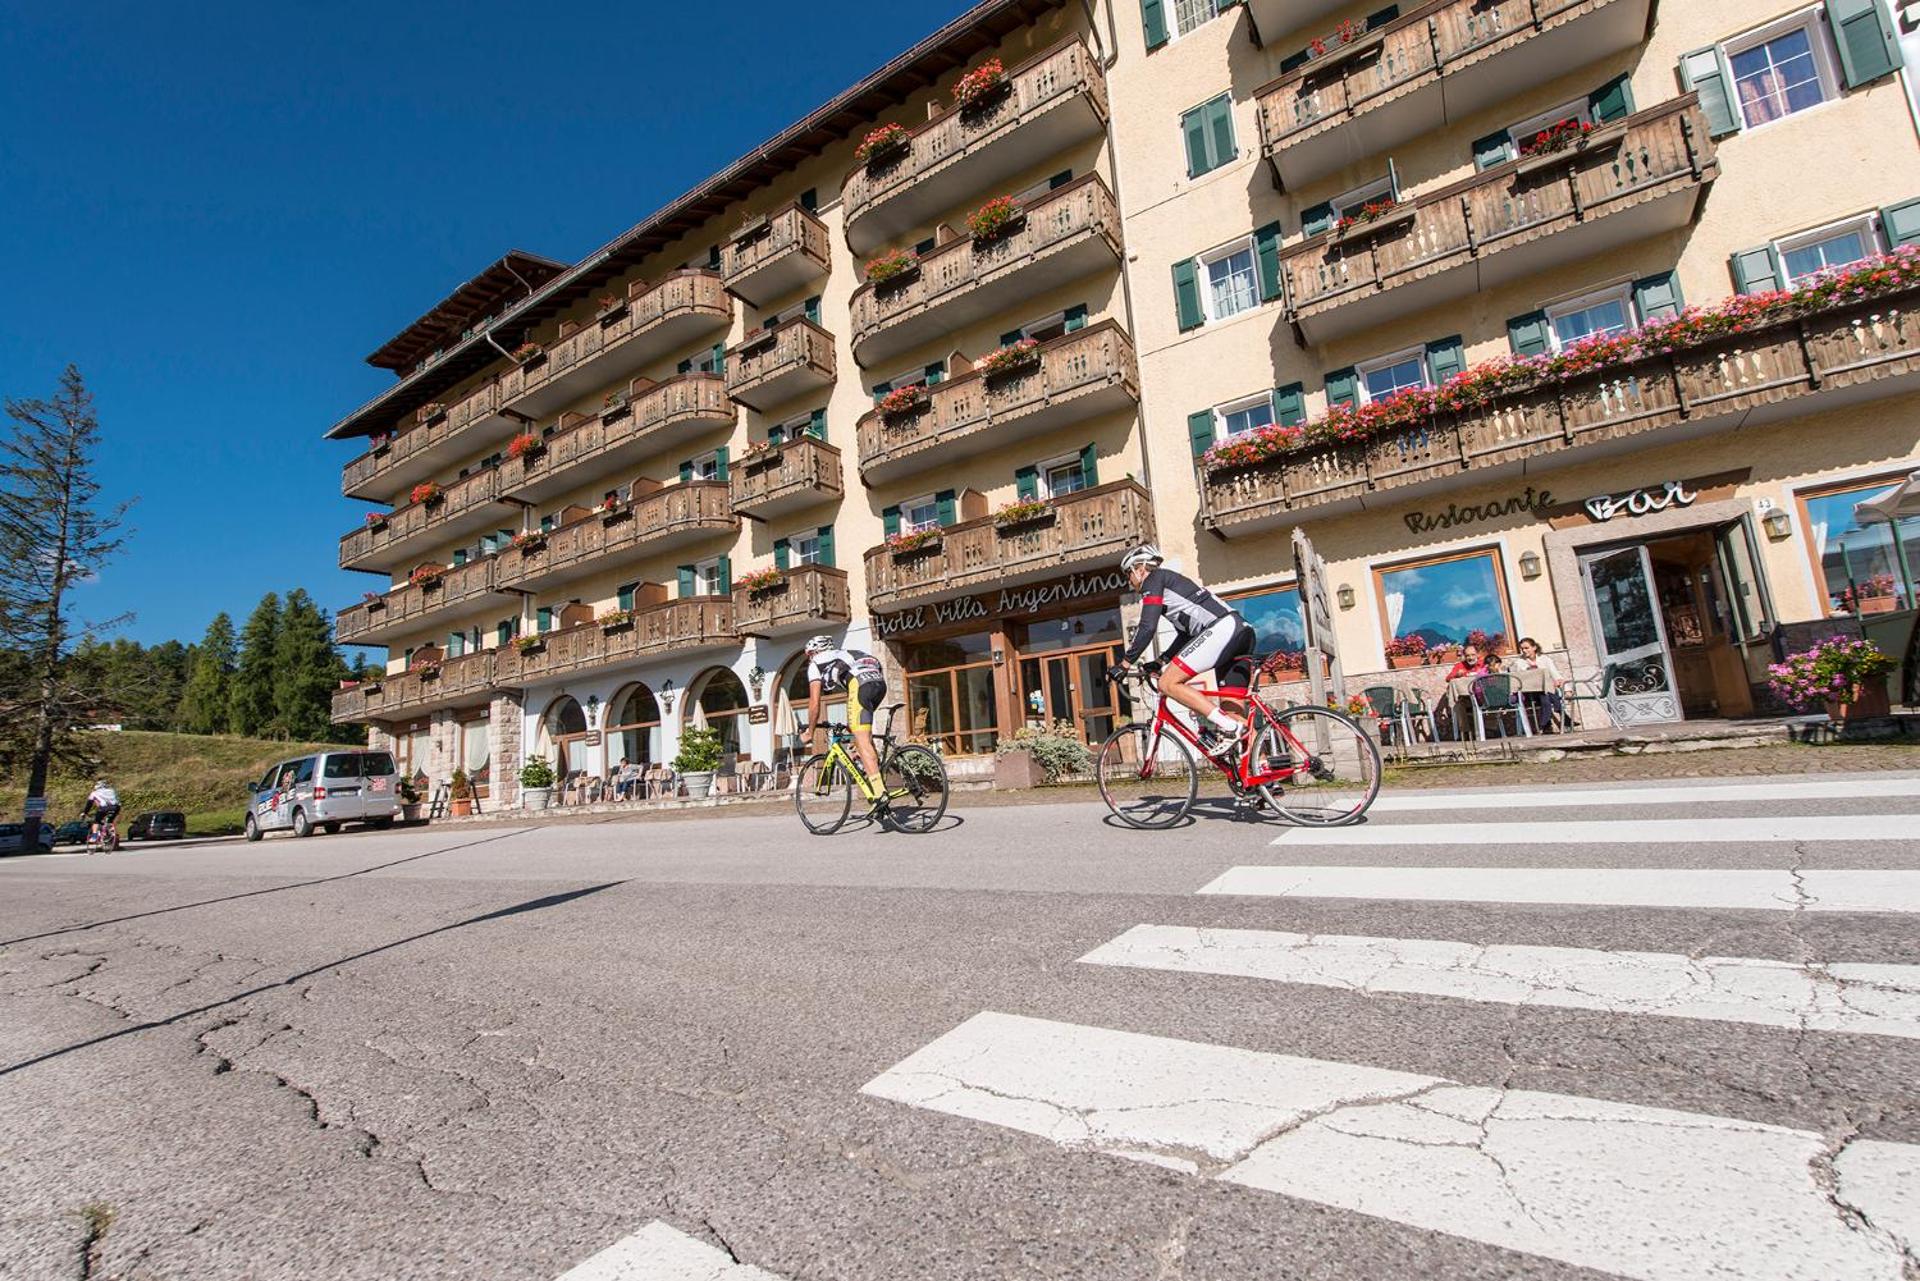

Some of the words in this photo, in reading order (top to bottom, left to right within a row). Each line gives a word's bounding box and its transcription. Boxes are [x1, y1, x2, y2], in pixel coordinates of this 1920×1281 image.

[1404, 487, 1557, 534] Ristorante
[1586, 480, 1697, 521] Bar
[876, 606, 926, 634] Hotel
[931, 596, 988, 624] Villa
[996, 572, 1128, 613] Argentina
